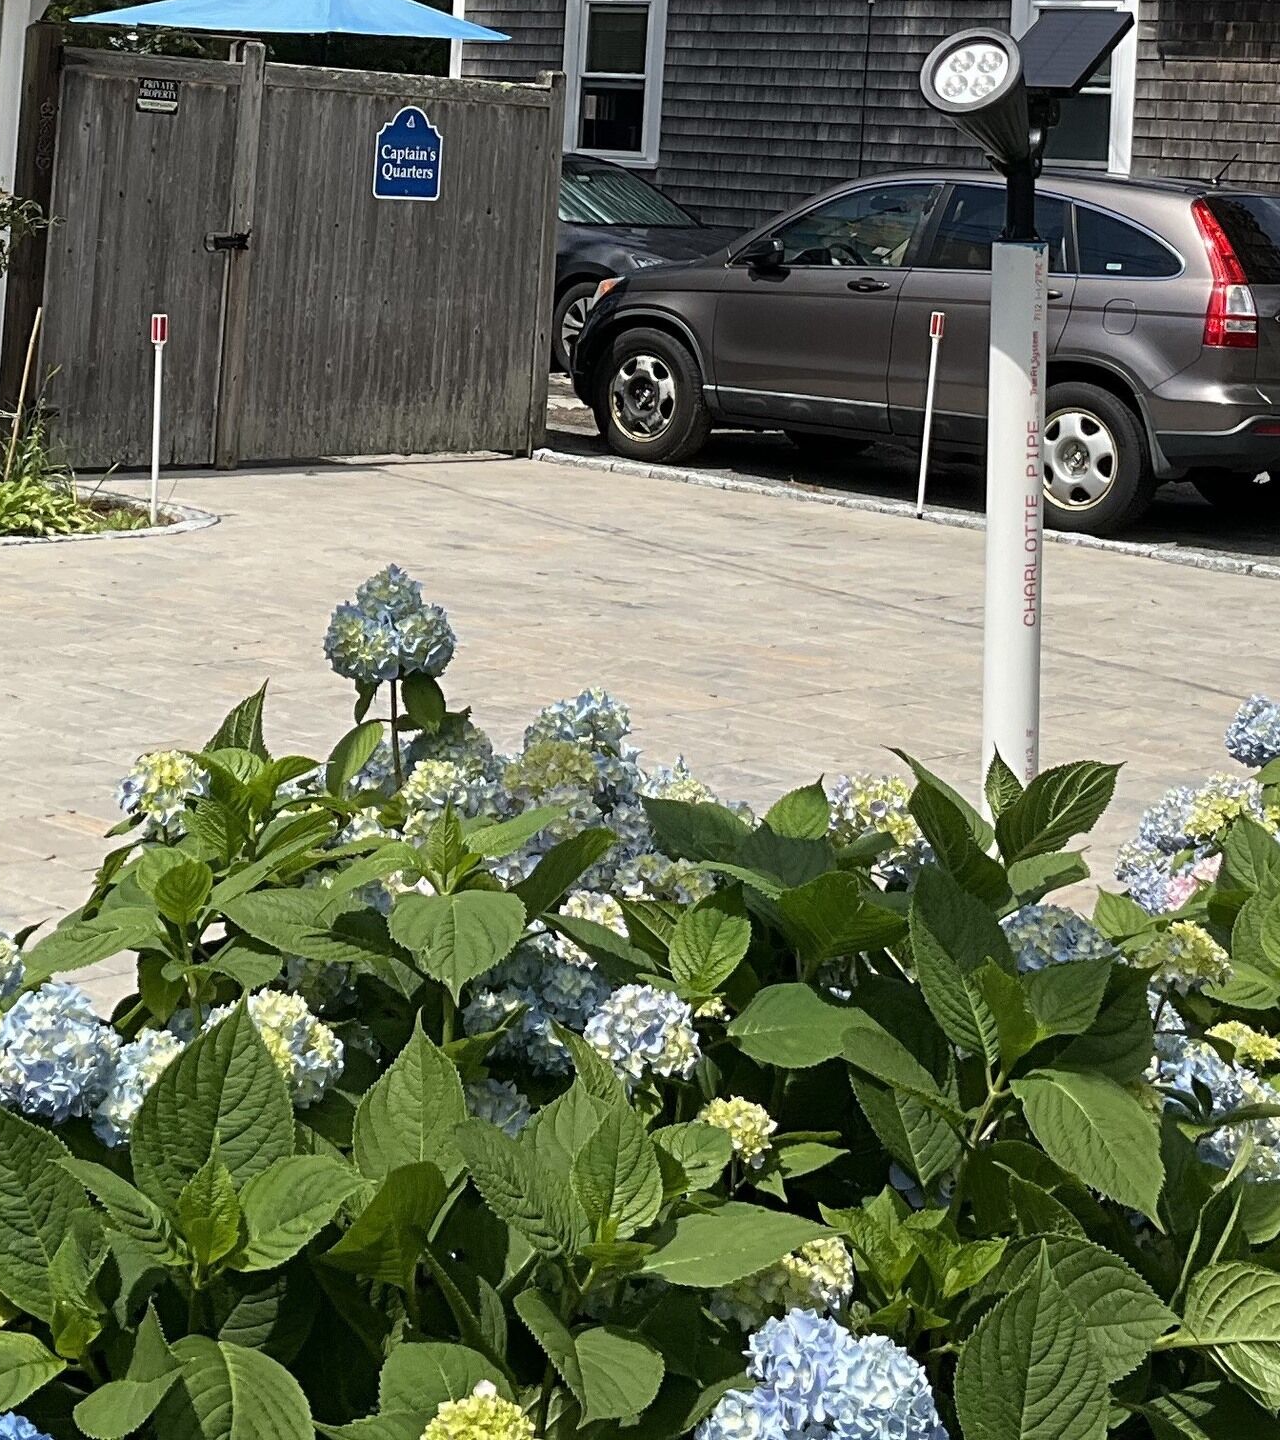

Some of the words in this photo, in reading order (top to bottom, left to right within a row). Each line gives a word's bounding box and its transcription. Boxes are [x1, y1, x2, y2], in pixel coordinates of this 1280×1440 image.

[139, 88, 177, 100] PROPERTY
[143, 79, 176, 90] PRIVATE
[381, 144, 437, 164] Captain's
[382, 162, 434, 180] Quarters
[1026, 420, 1041, 477] PIPE
[1023, 494, 1039, 627] CHARLOTTE
